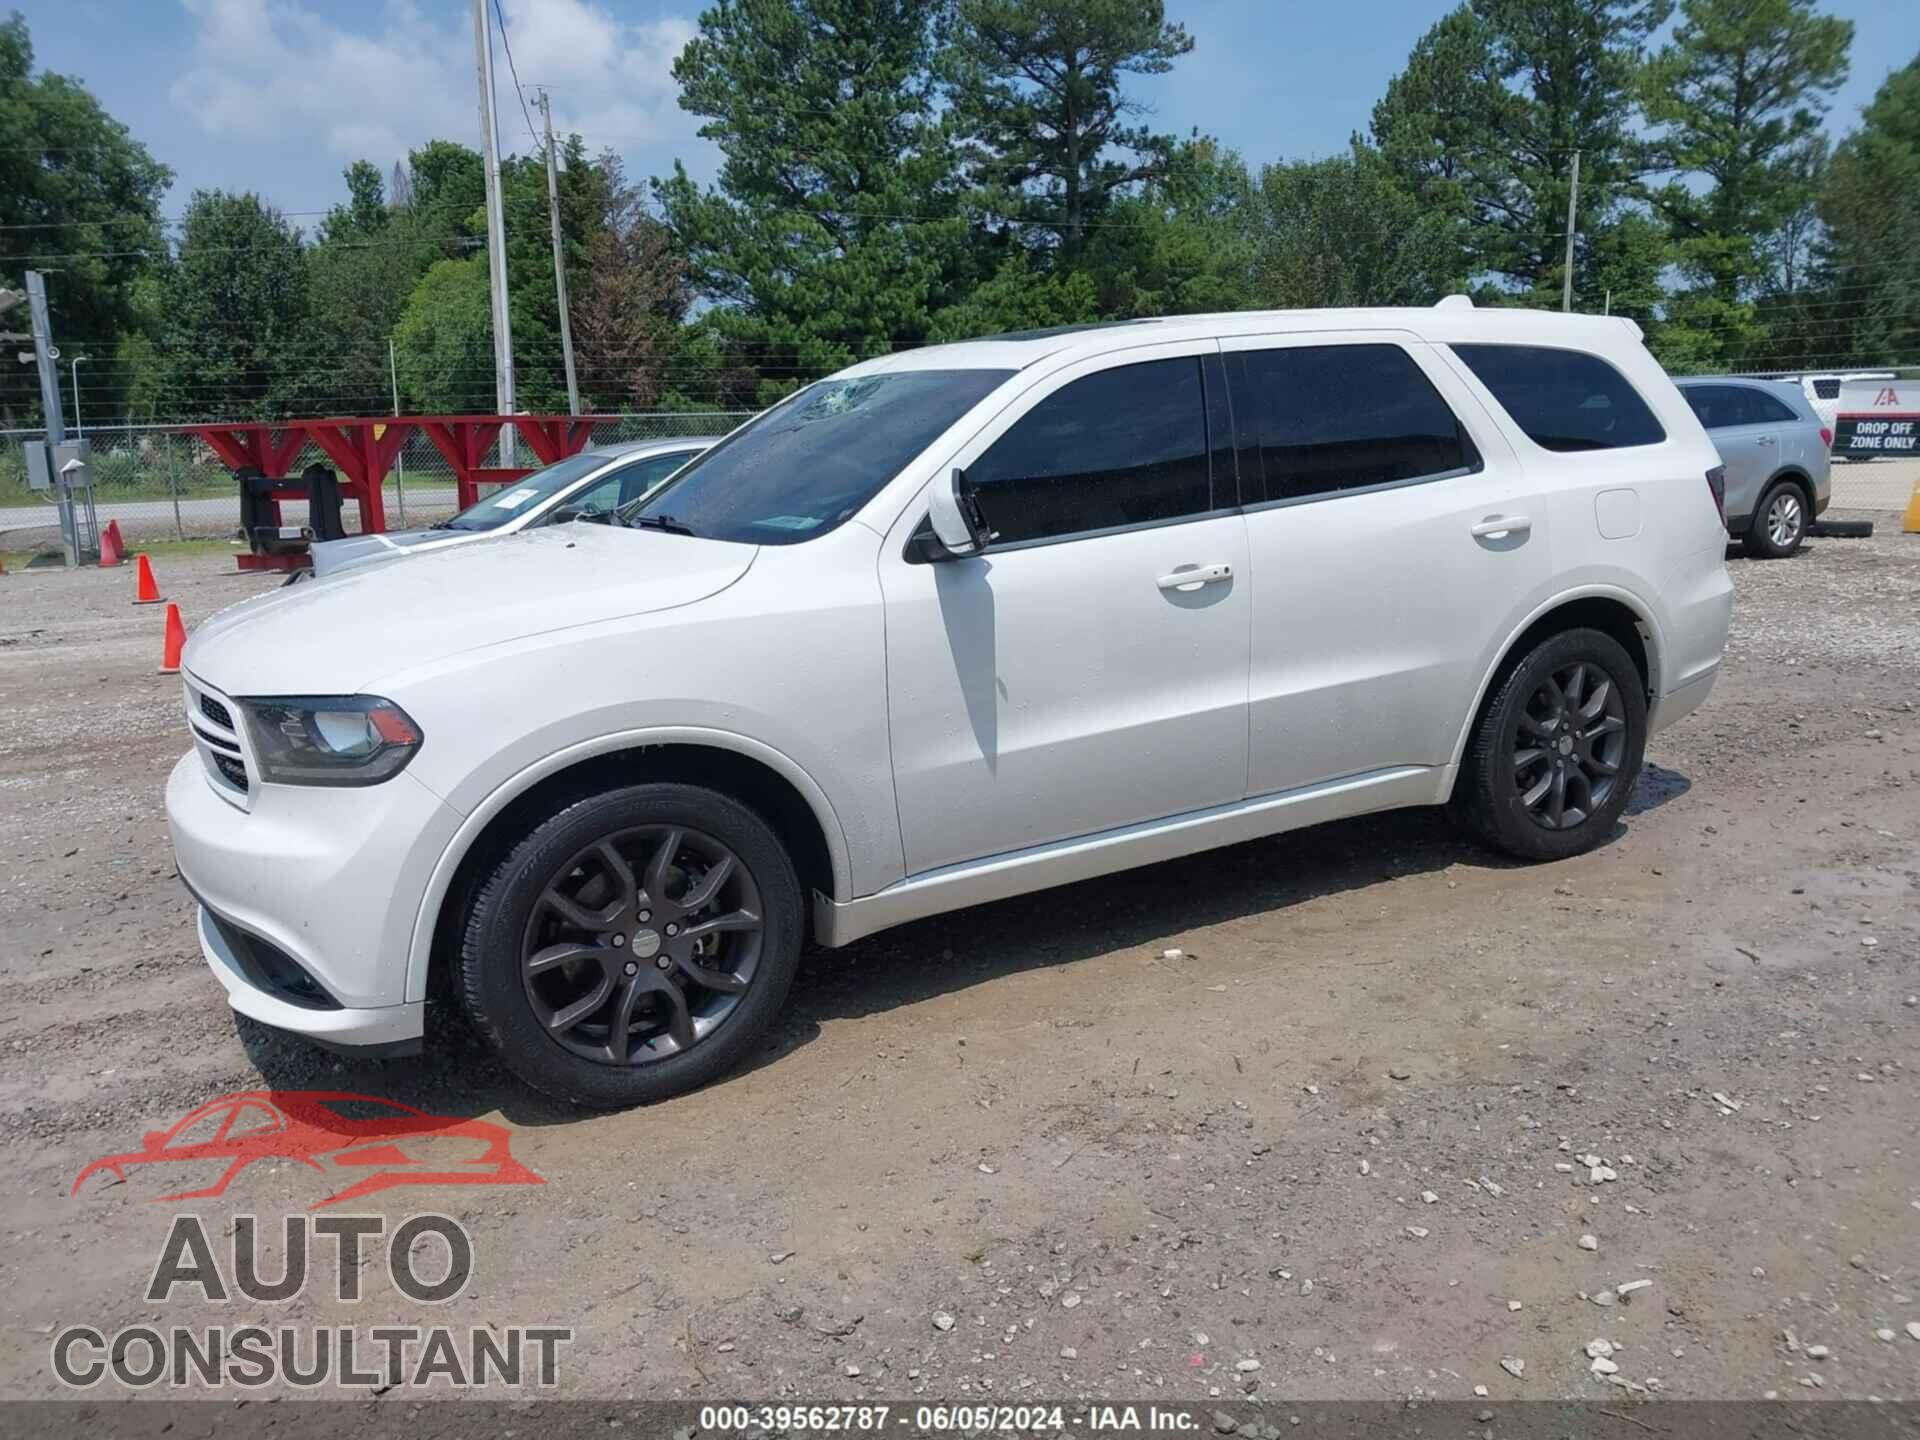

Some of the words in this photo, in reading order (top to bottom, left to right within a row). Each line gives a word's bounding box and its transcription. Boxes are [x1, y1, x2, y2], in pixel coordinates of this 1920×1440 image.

[1856, 422, 1888, 434] DROP
[1891, 422, 1914, 434] OFF
[1850, 436, 1881, 448] ZONE
[1884, 436, 1916, 448] ONLY
